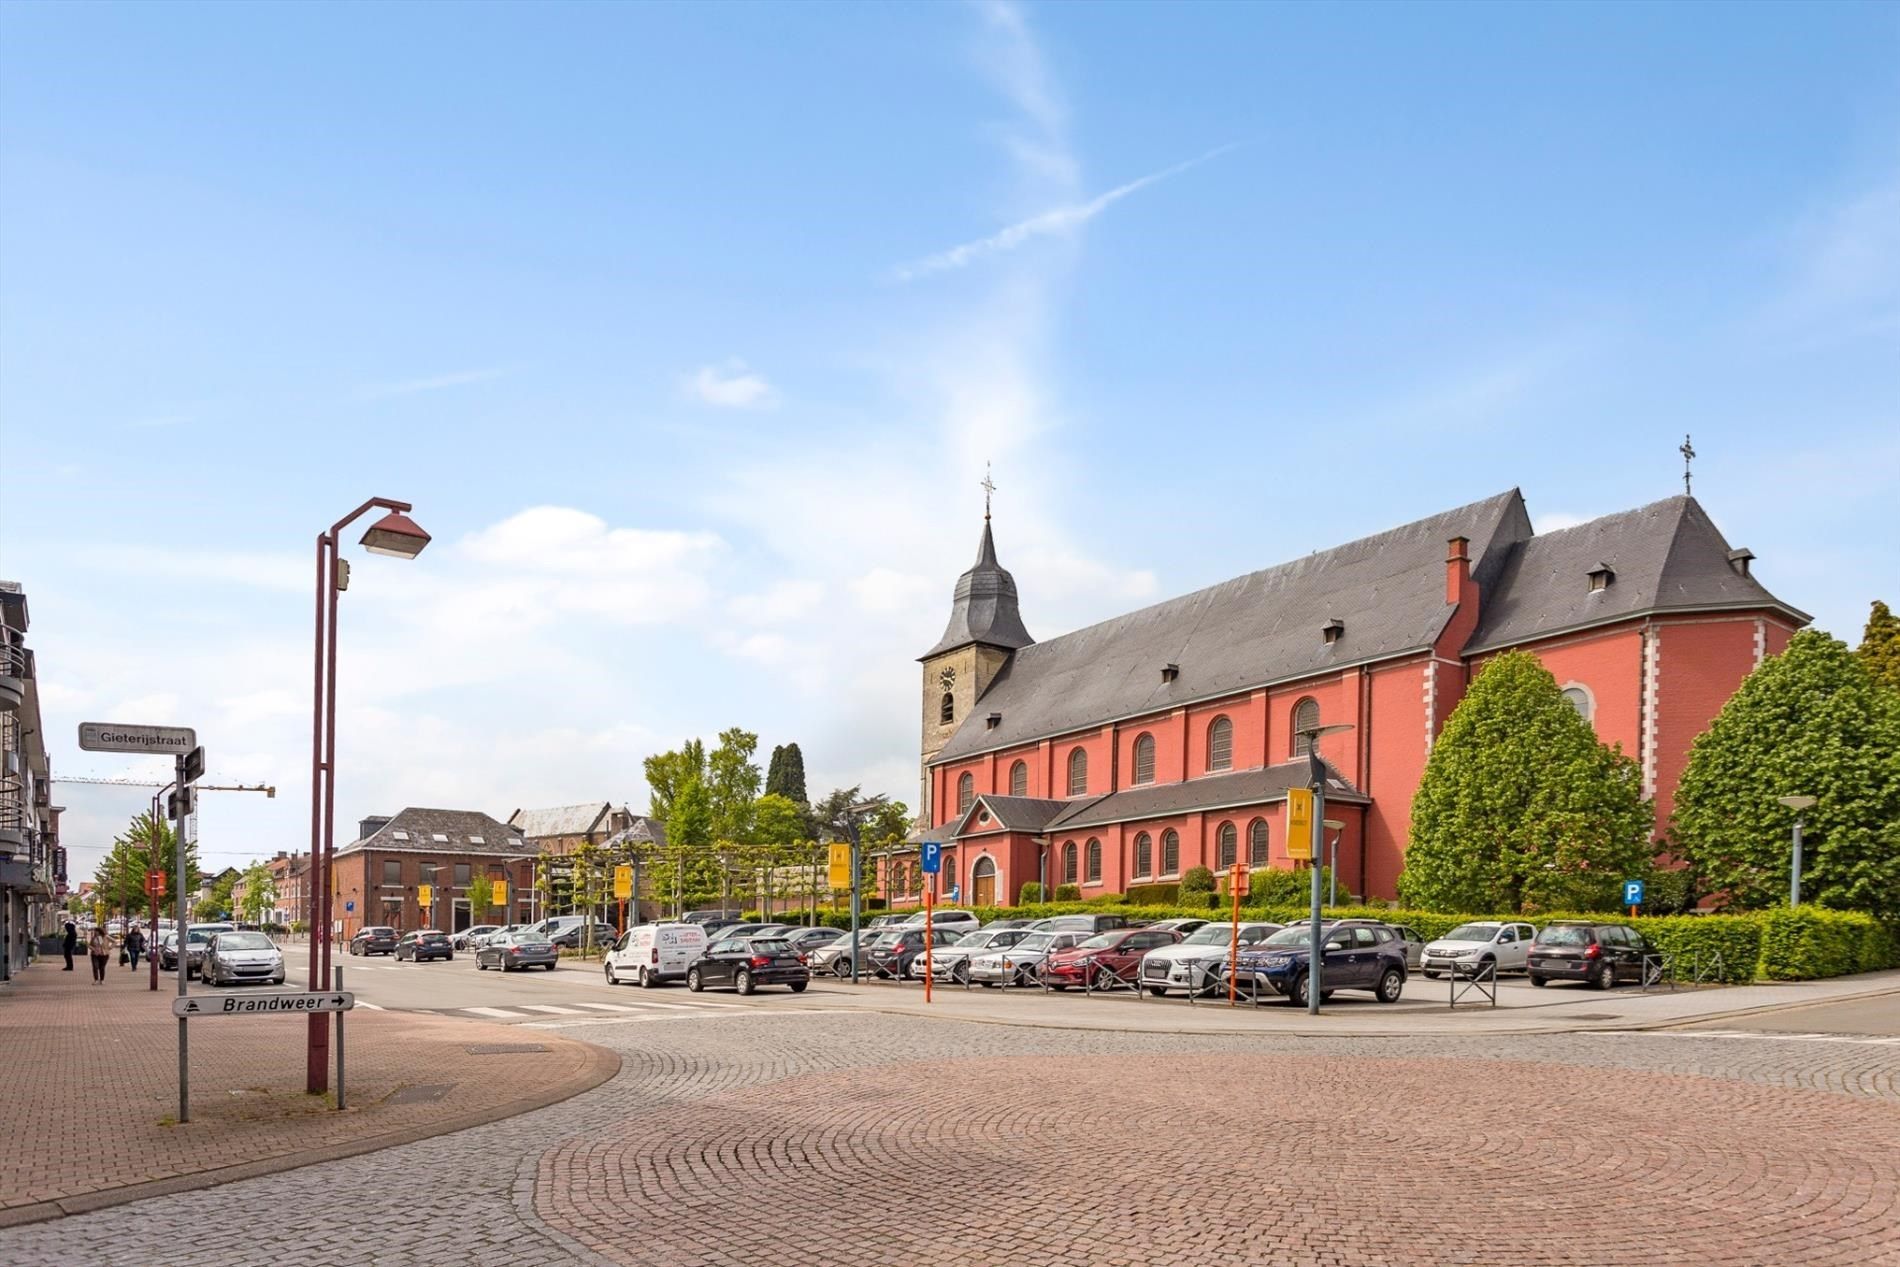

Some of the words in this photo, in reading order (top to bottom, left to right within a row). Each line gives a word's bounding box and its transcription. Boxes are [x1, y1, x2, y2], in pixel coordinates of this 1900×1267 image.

[101, 732, 187, 746] Gieterijstraat
[927, 844, 937, 861] P
[1627, 884, 1640, 900] P
[223, 997, 324, 1012] Brandweer
